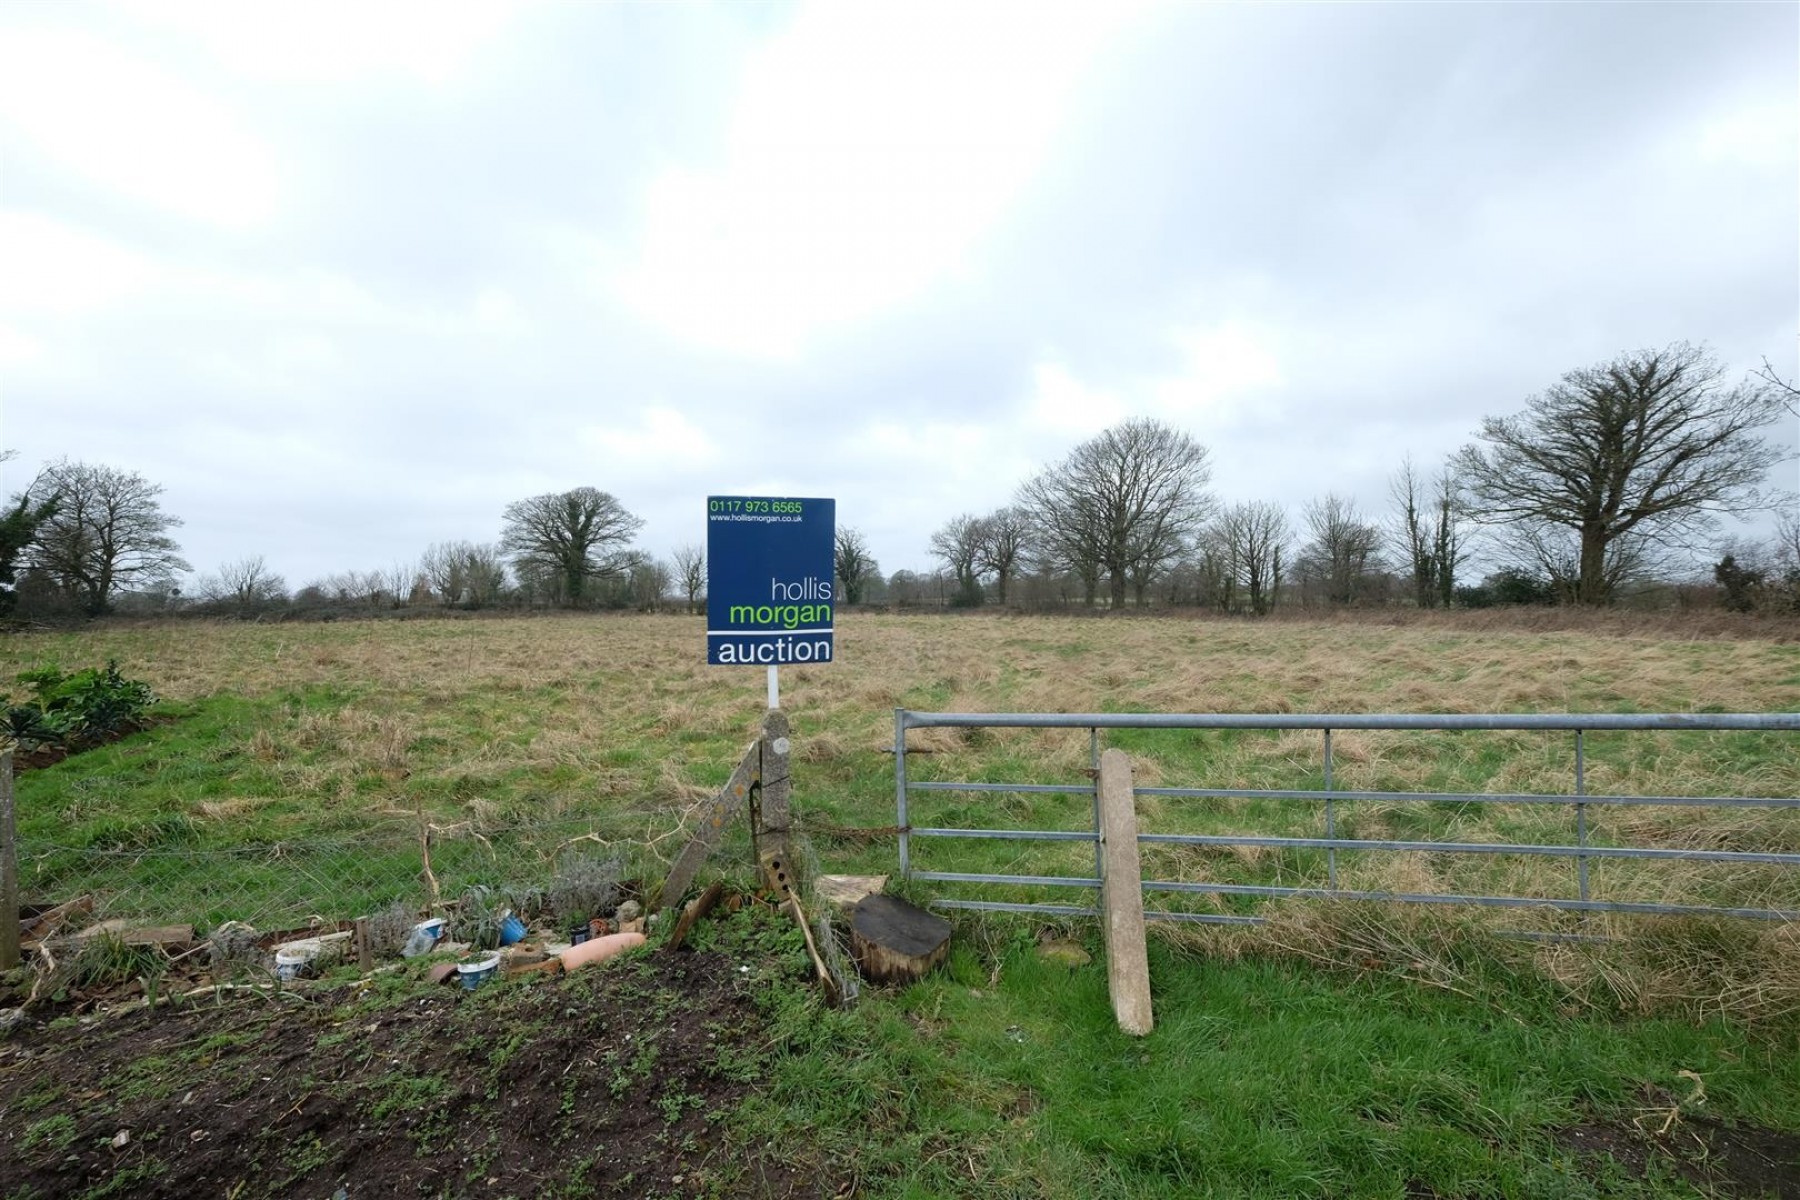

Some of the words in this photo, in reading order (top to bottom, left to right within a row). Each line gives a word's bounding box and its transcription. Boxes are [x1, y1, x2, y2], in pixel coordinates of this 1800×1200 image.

[710, 500, 741, 512] 0117
[745, 500, 769, 512] 973
[772, 501, 802, 513] 6565
[710, 514, 802, 523] www.hollismorgan.co.uk
[772, 577, 831, 601] hollis
[730, 604, 831, 629] morgan
[718, 636, 830, 663] auction
